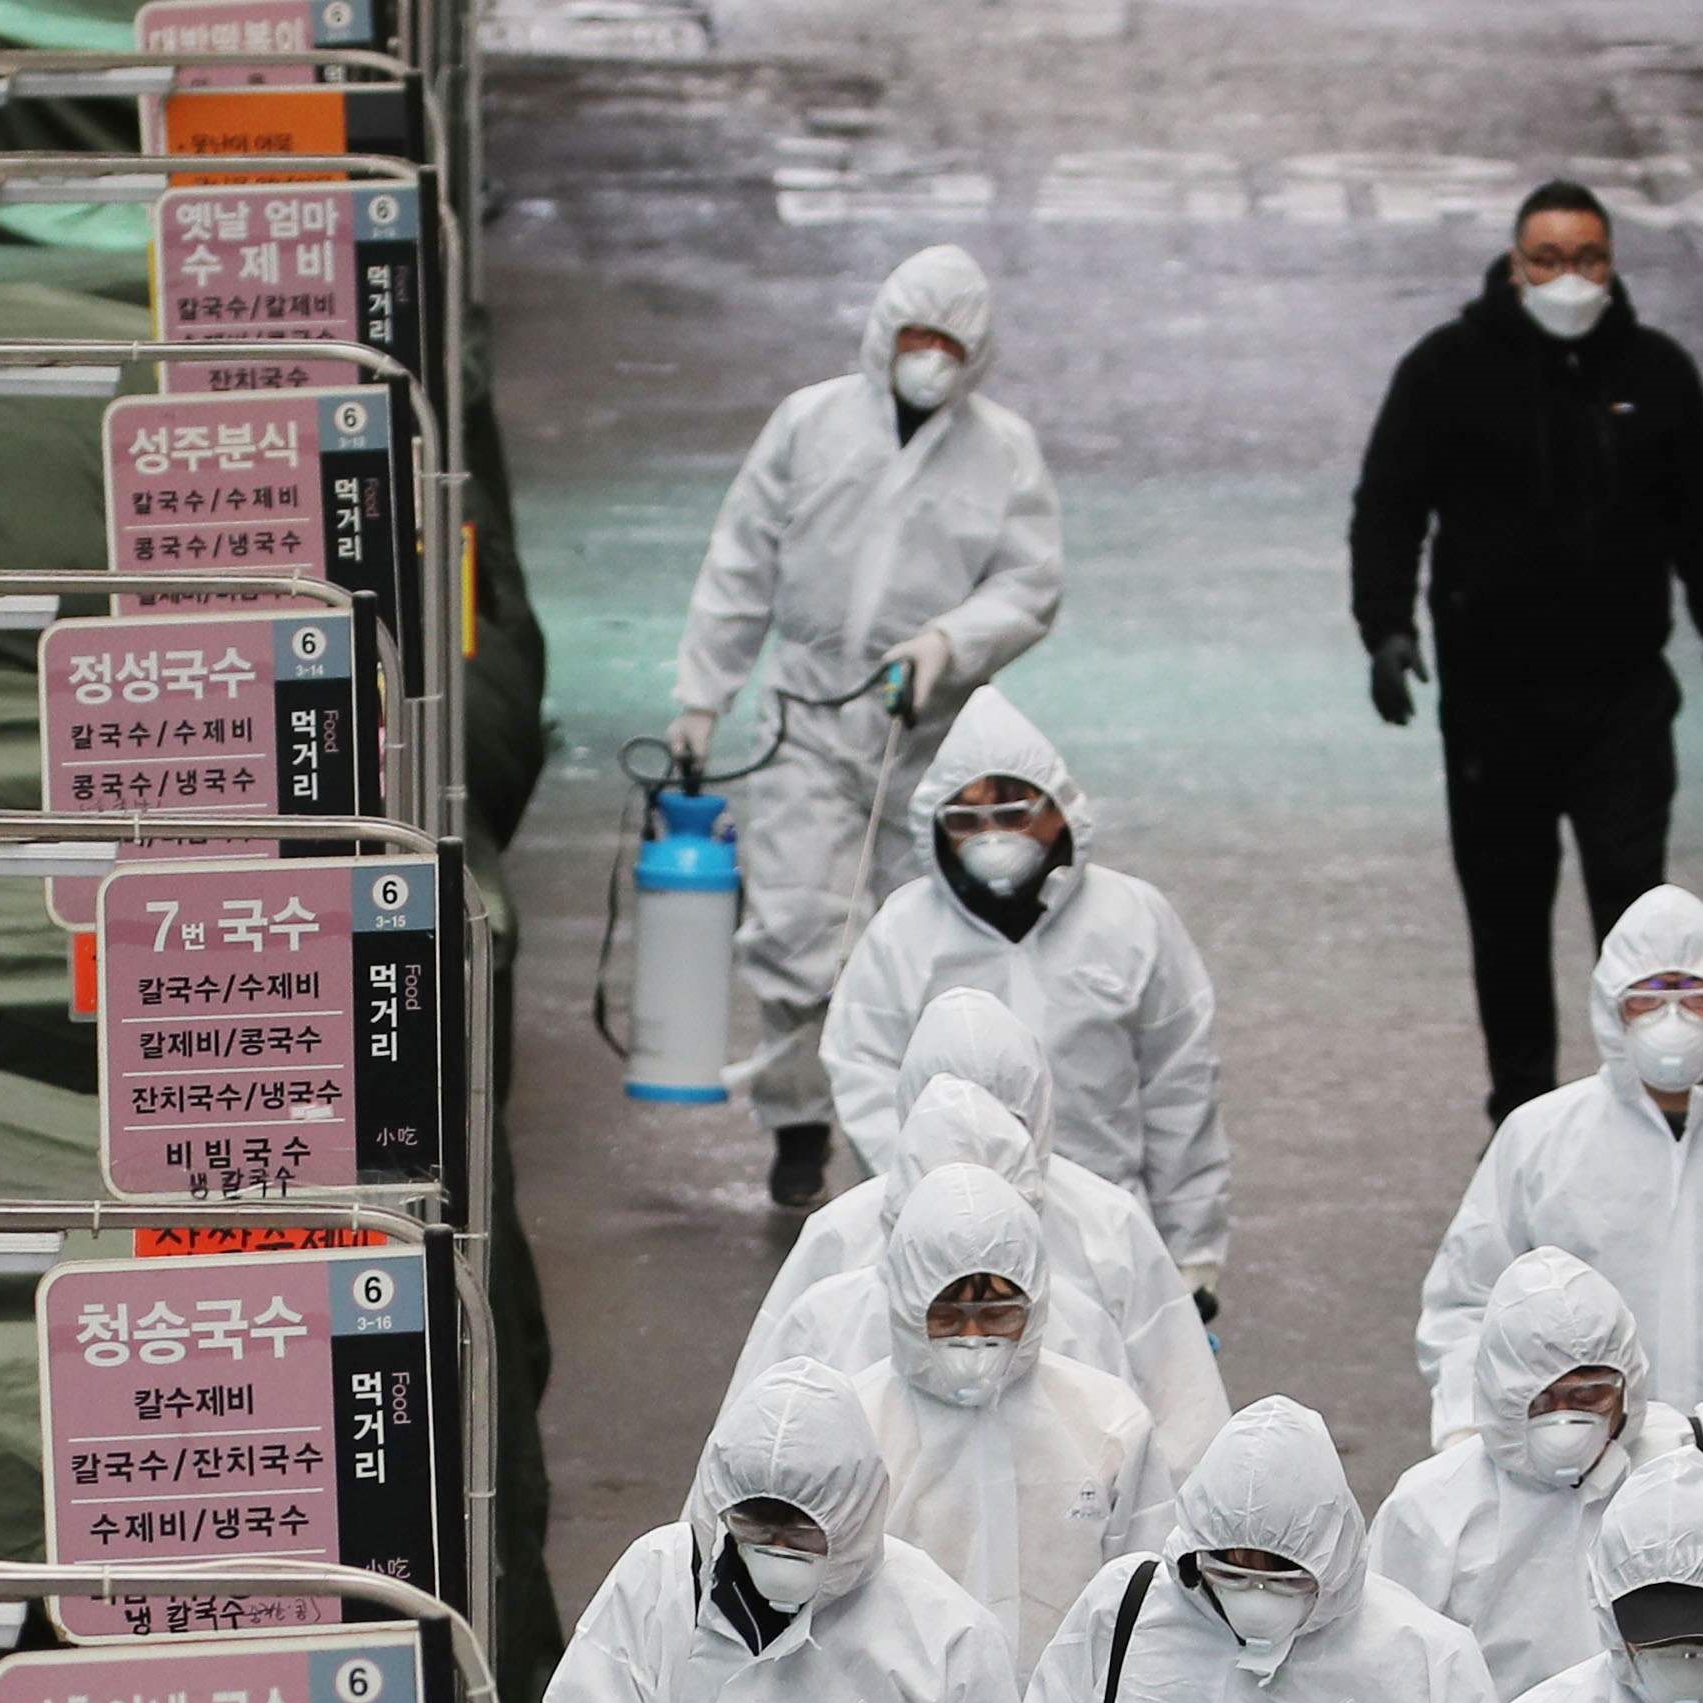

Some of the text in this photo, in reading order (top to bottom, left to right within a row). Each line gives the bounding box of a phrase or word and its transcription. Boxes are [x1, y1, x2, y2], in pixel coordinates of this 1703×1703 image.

[176, 198, 339, 241] 옛날 엄마
[367, 264, 394, 345] 먹거리
[209, 366, 309, 391] 잔치국수
[344, 407, 358, 429] 6
[128, 420, 300, 475] 성주분식
[334, 477, 363, 563] 먹거리
[301, 632, 316, 655] 6
[68, 647, 257, 705] 정성국수
[71, 717, 254, 750] 칼국수/수제비
[323, 710, 339, 754] Food
[291, 709, 319, 801] 먹거리
[71, 767, 257, 800] 콩국수/냉국수
[381, 880, 398, 905] 6
[145, 896, 320, 953] 7번 국수
[375, 915, 406, 928] 3-15
[138, 971, 320, 1005] 칼국수/수제비
[404, 964, 421, 1011] Food
[369, 962, 398, 1062] 먹거리
[139, 1026, 322, 1059] 칼제비/콩국수
[132, 1080, 343, 1114] 잔치국수/냉국수
[165, 1136, 312, 1171] 비빔국수
[376, 1126, 418, 1147] 小吃
[364, 1276, 382, 1303] 6
[75, 1295, 309, 1367] 청송국수
[357, 1315, 393, 1331] 3-16
[134, 1384, 254, 1420] 칼수제비
[392, 1371, 412, 1425] Food
[351, 1371, 386, 1485] 먹거리
[72, 1442, 325, 1485] 칼국수/잔치국수
[90, 1503, 310, 1545] 수제비/냉국수
[348, 1668, 369, 1696] 6
